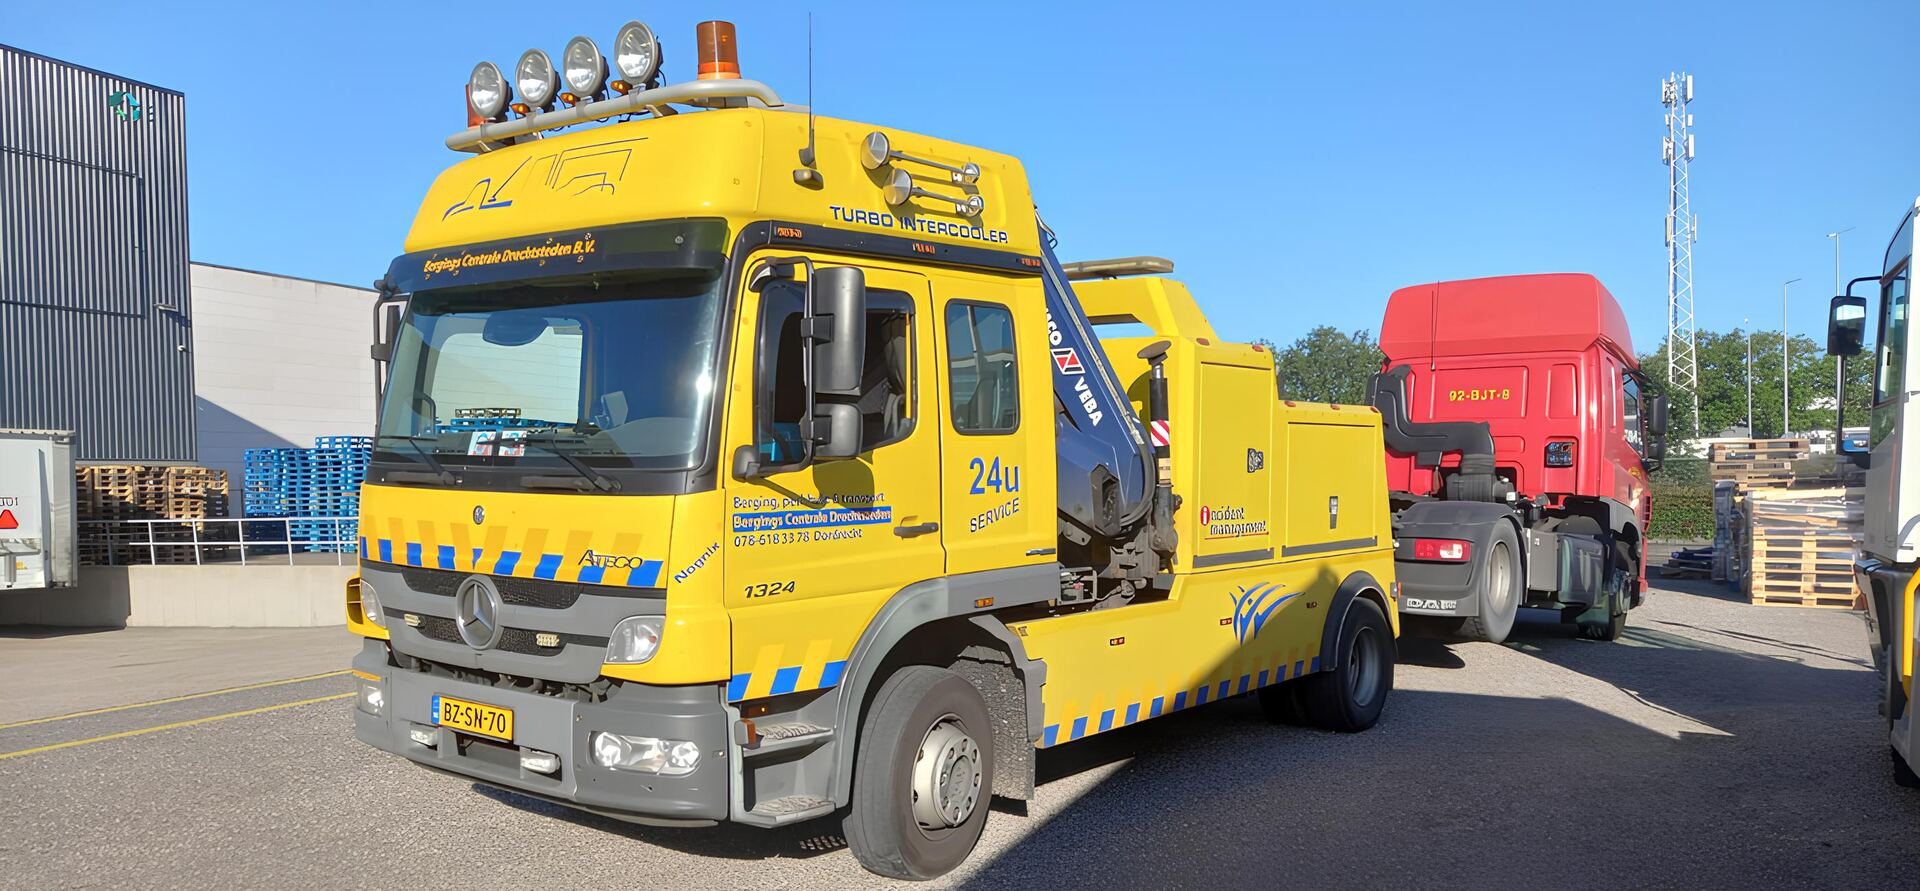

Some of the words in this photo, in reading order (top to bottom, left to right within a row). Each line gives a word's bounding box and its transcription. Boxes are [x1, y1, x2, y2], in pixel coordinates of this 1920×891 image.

[829, 205, 894, 228] TURBO
[900, 216, 1008, 244] INTERCOOLER
[462, 250, 502, 267] Centrale
[573, 239, 596, 255] B.V.
[1074, 376, 1103, 427] VEBA
[969, 455, 1019, 495] 24u
[733, 496, 780, 511] Berging,
[969, 497, 1020, 533] SERVICE
[744, 580, 796, 599] 1324
[444, 702, 506, 733] BZ-SN-70
